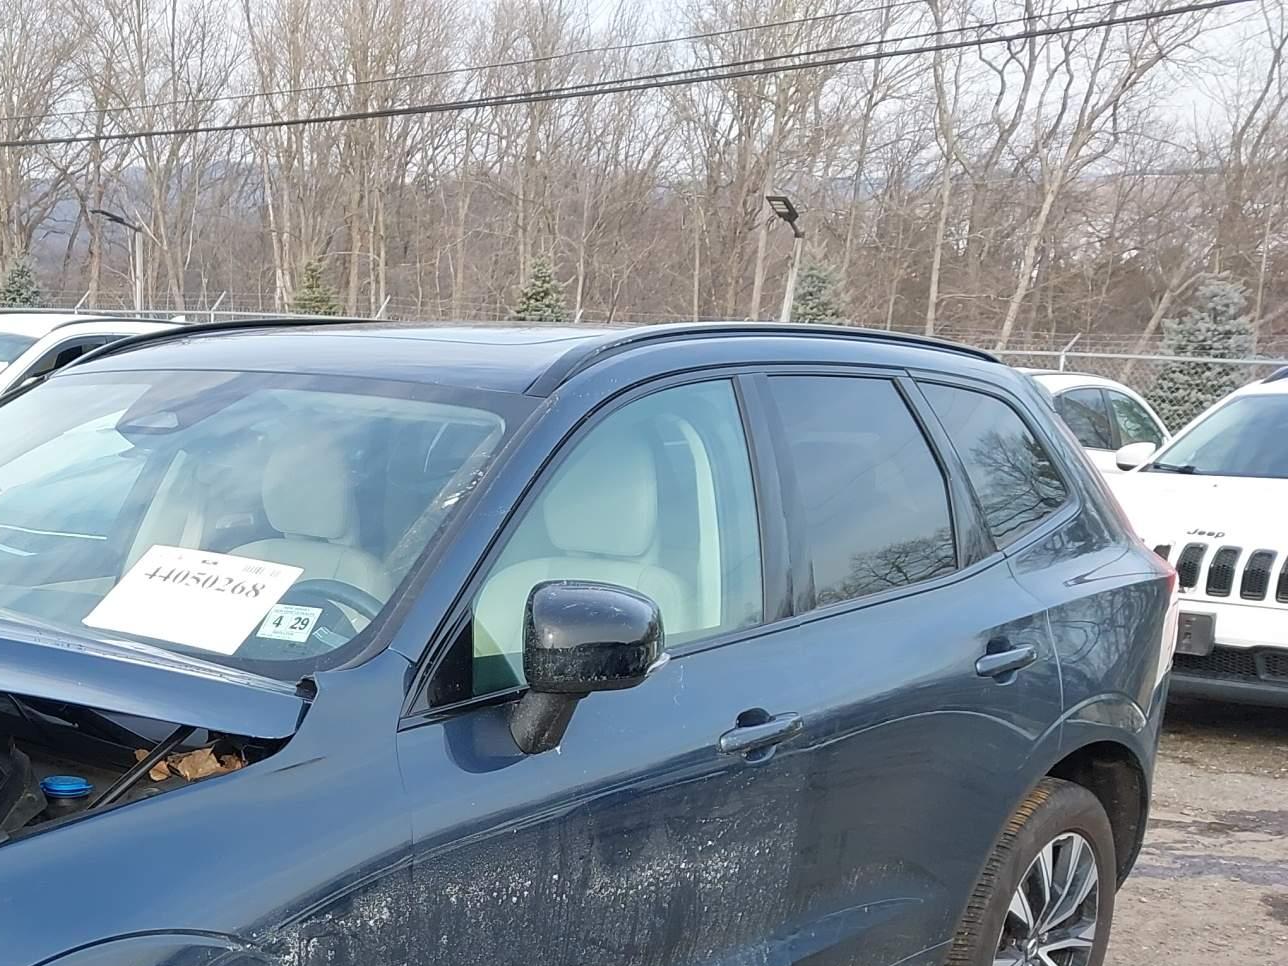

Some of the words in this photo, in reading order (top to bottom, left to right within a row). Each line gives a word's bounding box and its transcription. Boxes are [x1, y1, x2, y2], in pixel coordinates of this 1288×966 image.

[1186, 528, 1225, 539] Jeep
[144, 566, 266, 598] 44050268
[272, 615, 284, 628] 4
[289, 616, 310, 630] 29
